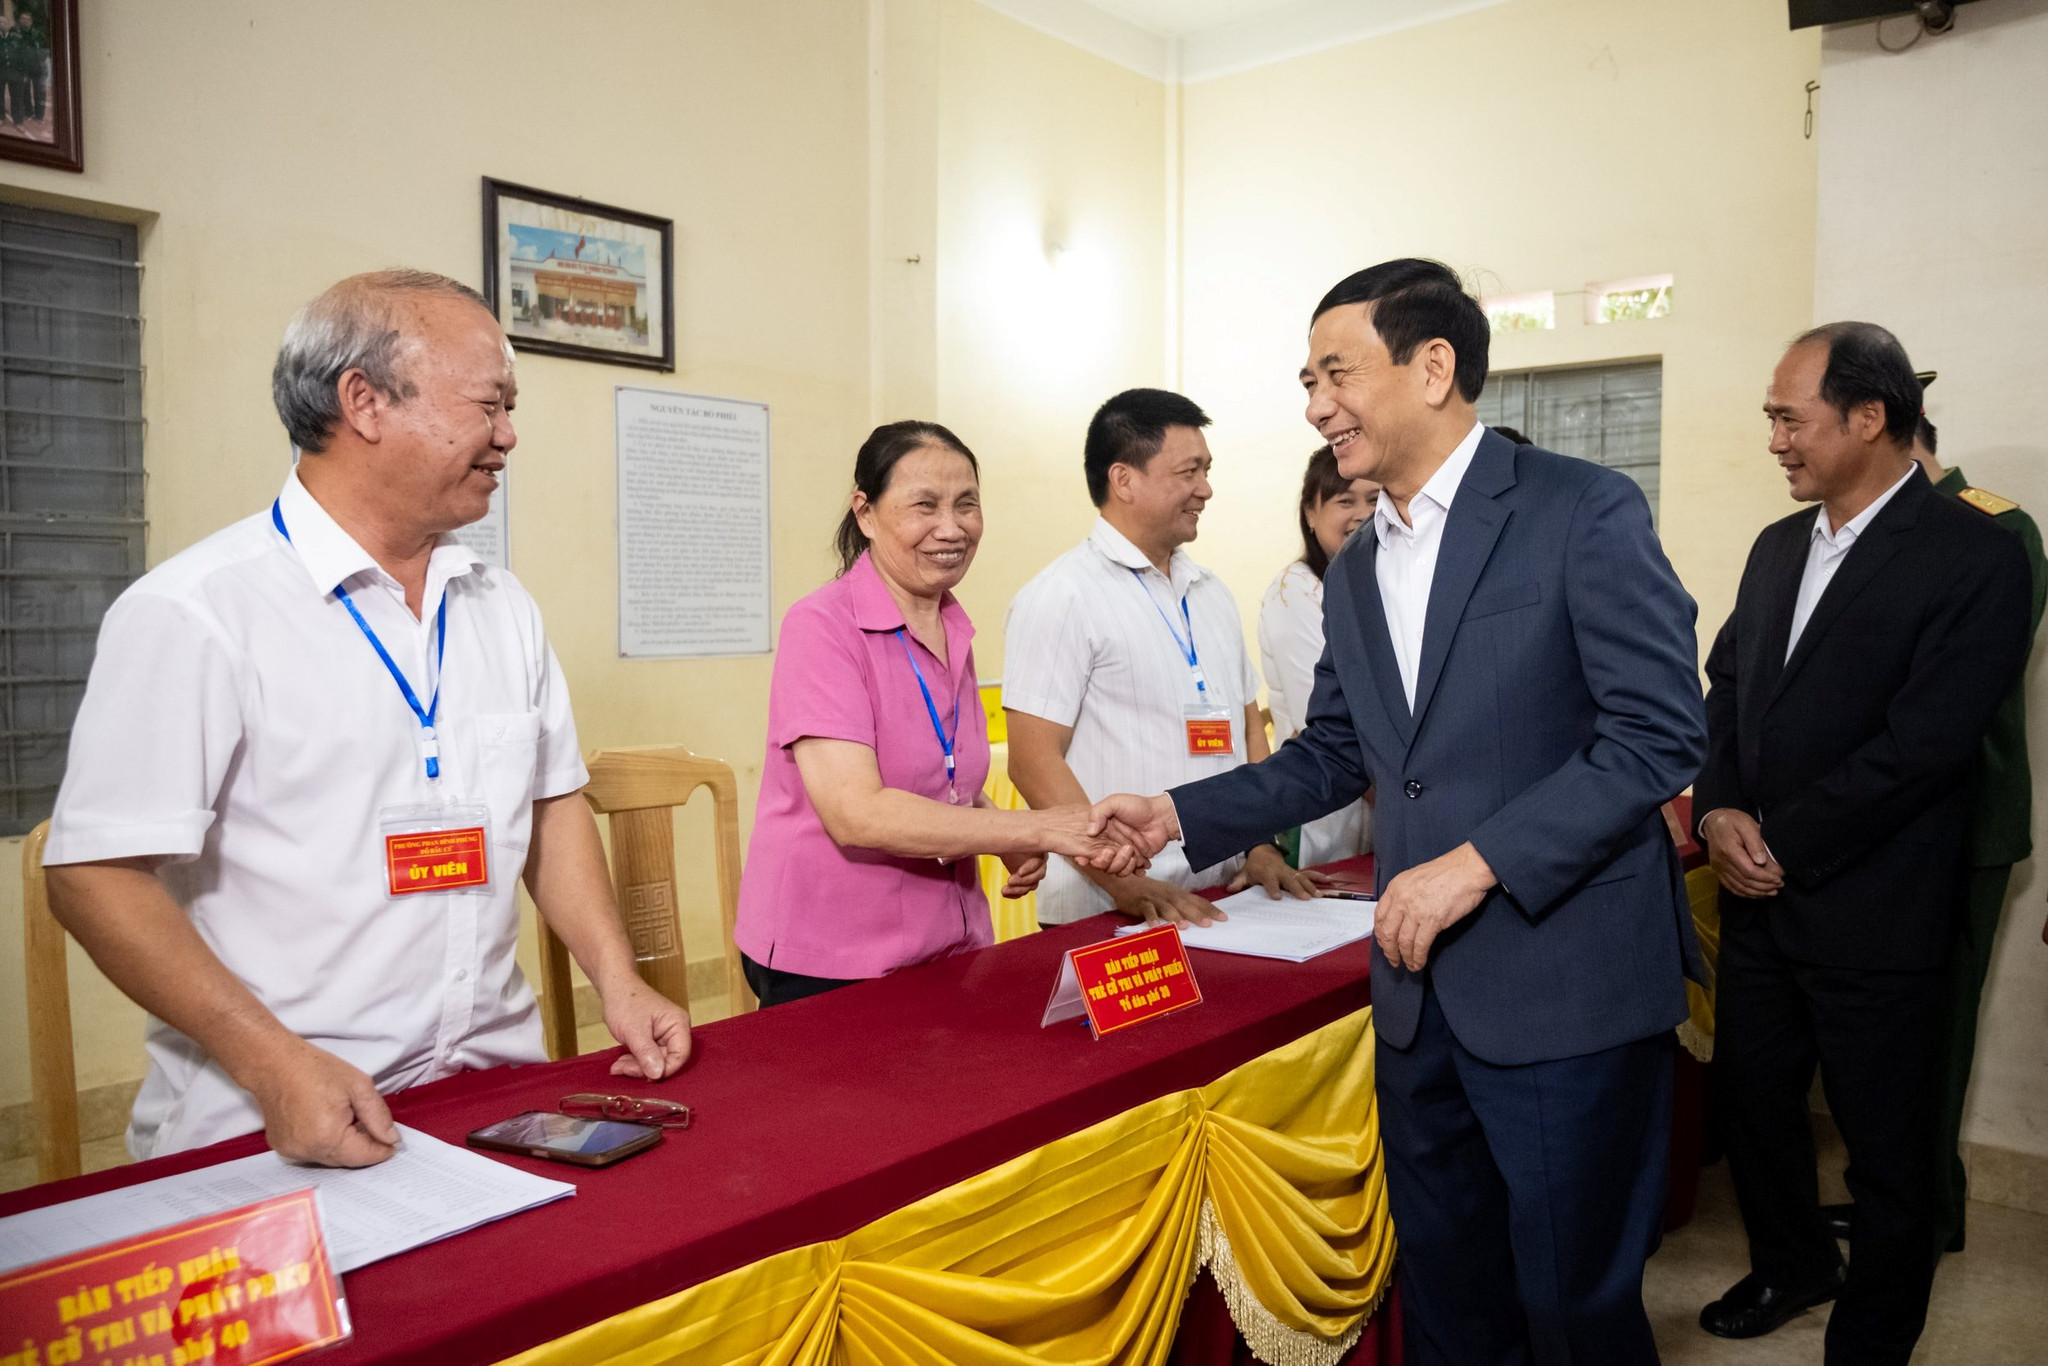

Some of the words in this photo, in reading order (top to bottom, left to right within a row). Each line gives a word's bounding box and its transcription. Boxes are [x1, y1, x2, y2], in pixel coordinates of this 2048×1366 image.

[409, 863, 429, 880] ỦY
[432, 861, 468, 878] VIÊN
[1121, 951, 1139, 970] TIẾP
[1117, 976, 1134, 992] TRI
[1131, 970, 1144, 987] VÀ
[115, 1261, 175, 1304] TIẾP
